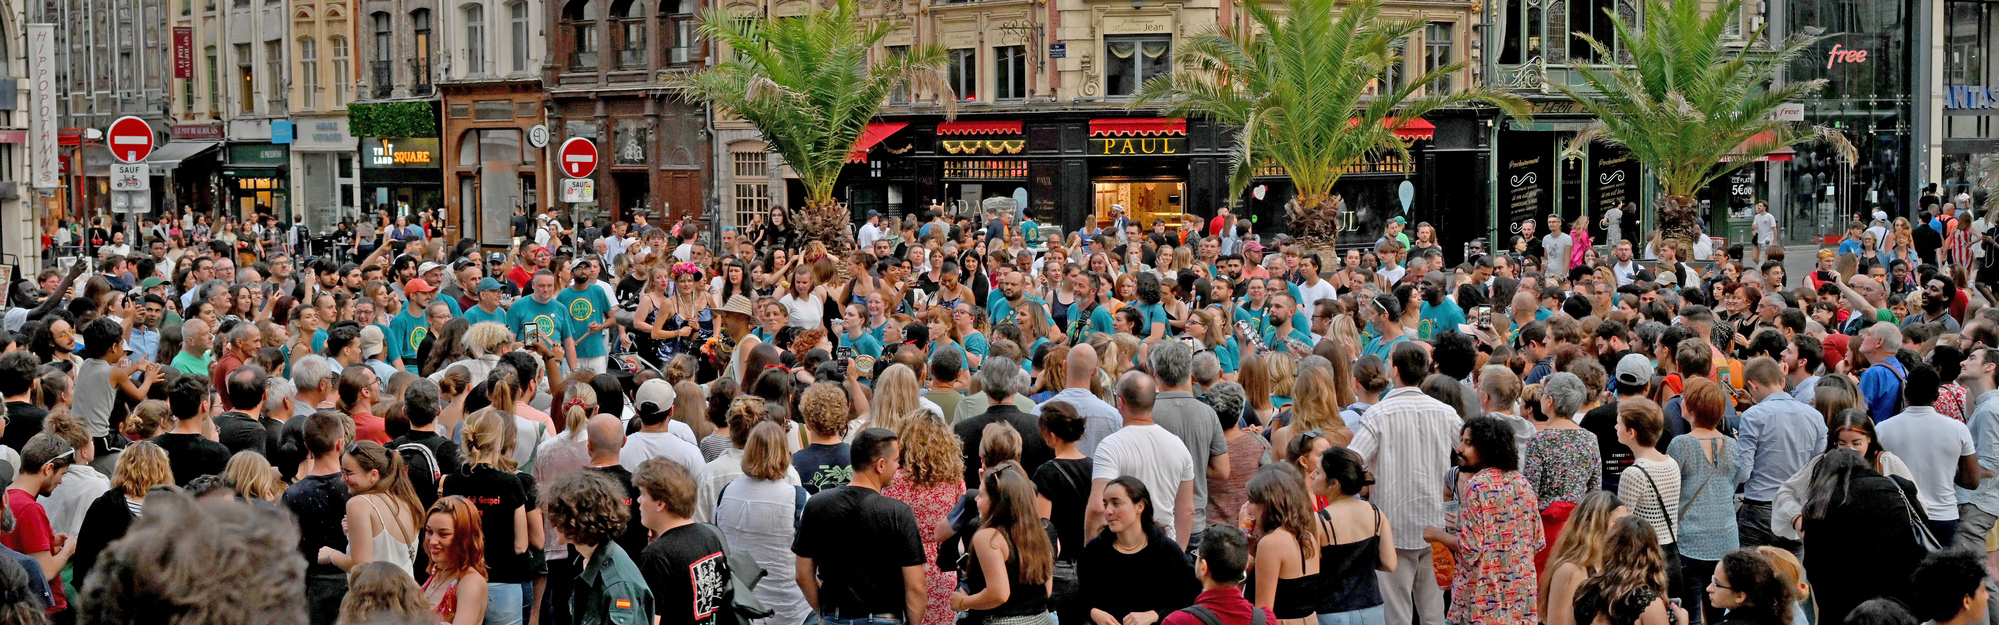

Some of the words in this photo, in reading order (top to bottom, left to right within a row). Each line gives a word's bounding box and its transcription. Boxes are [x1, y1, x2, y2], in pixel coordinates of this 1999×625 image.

[1143, 23, 1164, 32] Jean
[183, 36, 191, 77] BEAUJOLAIS
[1827, 44, 1868, 69] free
[36, 31, 53, 182] HIPPOPOTAMUS
[1779, 107, 1800, 116] free
[182, 127, 190, 135] POT
[1103, 138, 1176, 154] PAUL
[373, 156, 393, 165] LAND
[393, 151, 431, 164] SQUARE
[1732, 184, 1753, 195] 5€00
[479, 496, 500, 506] Gospel
